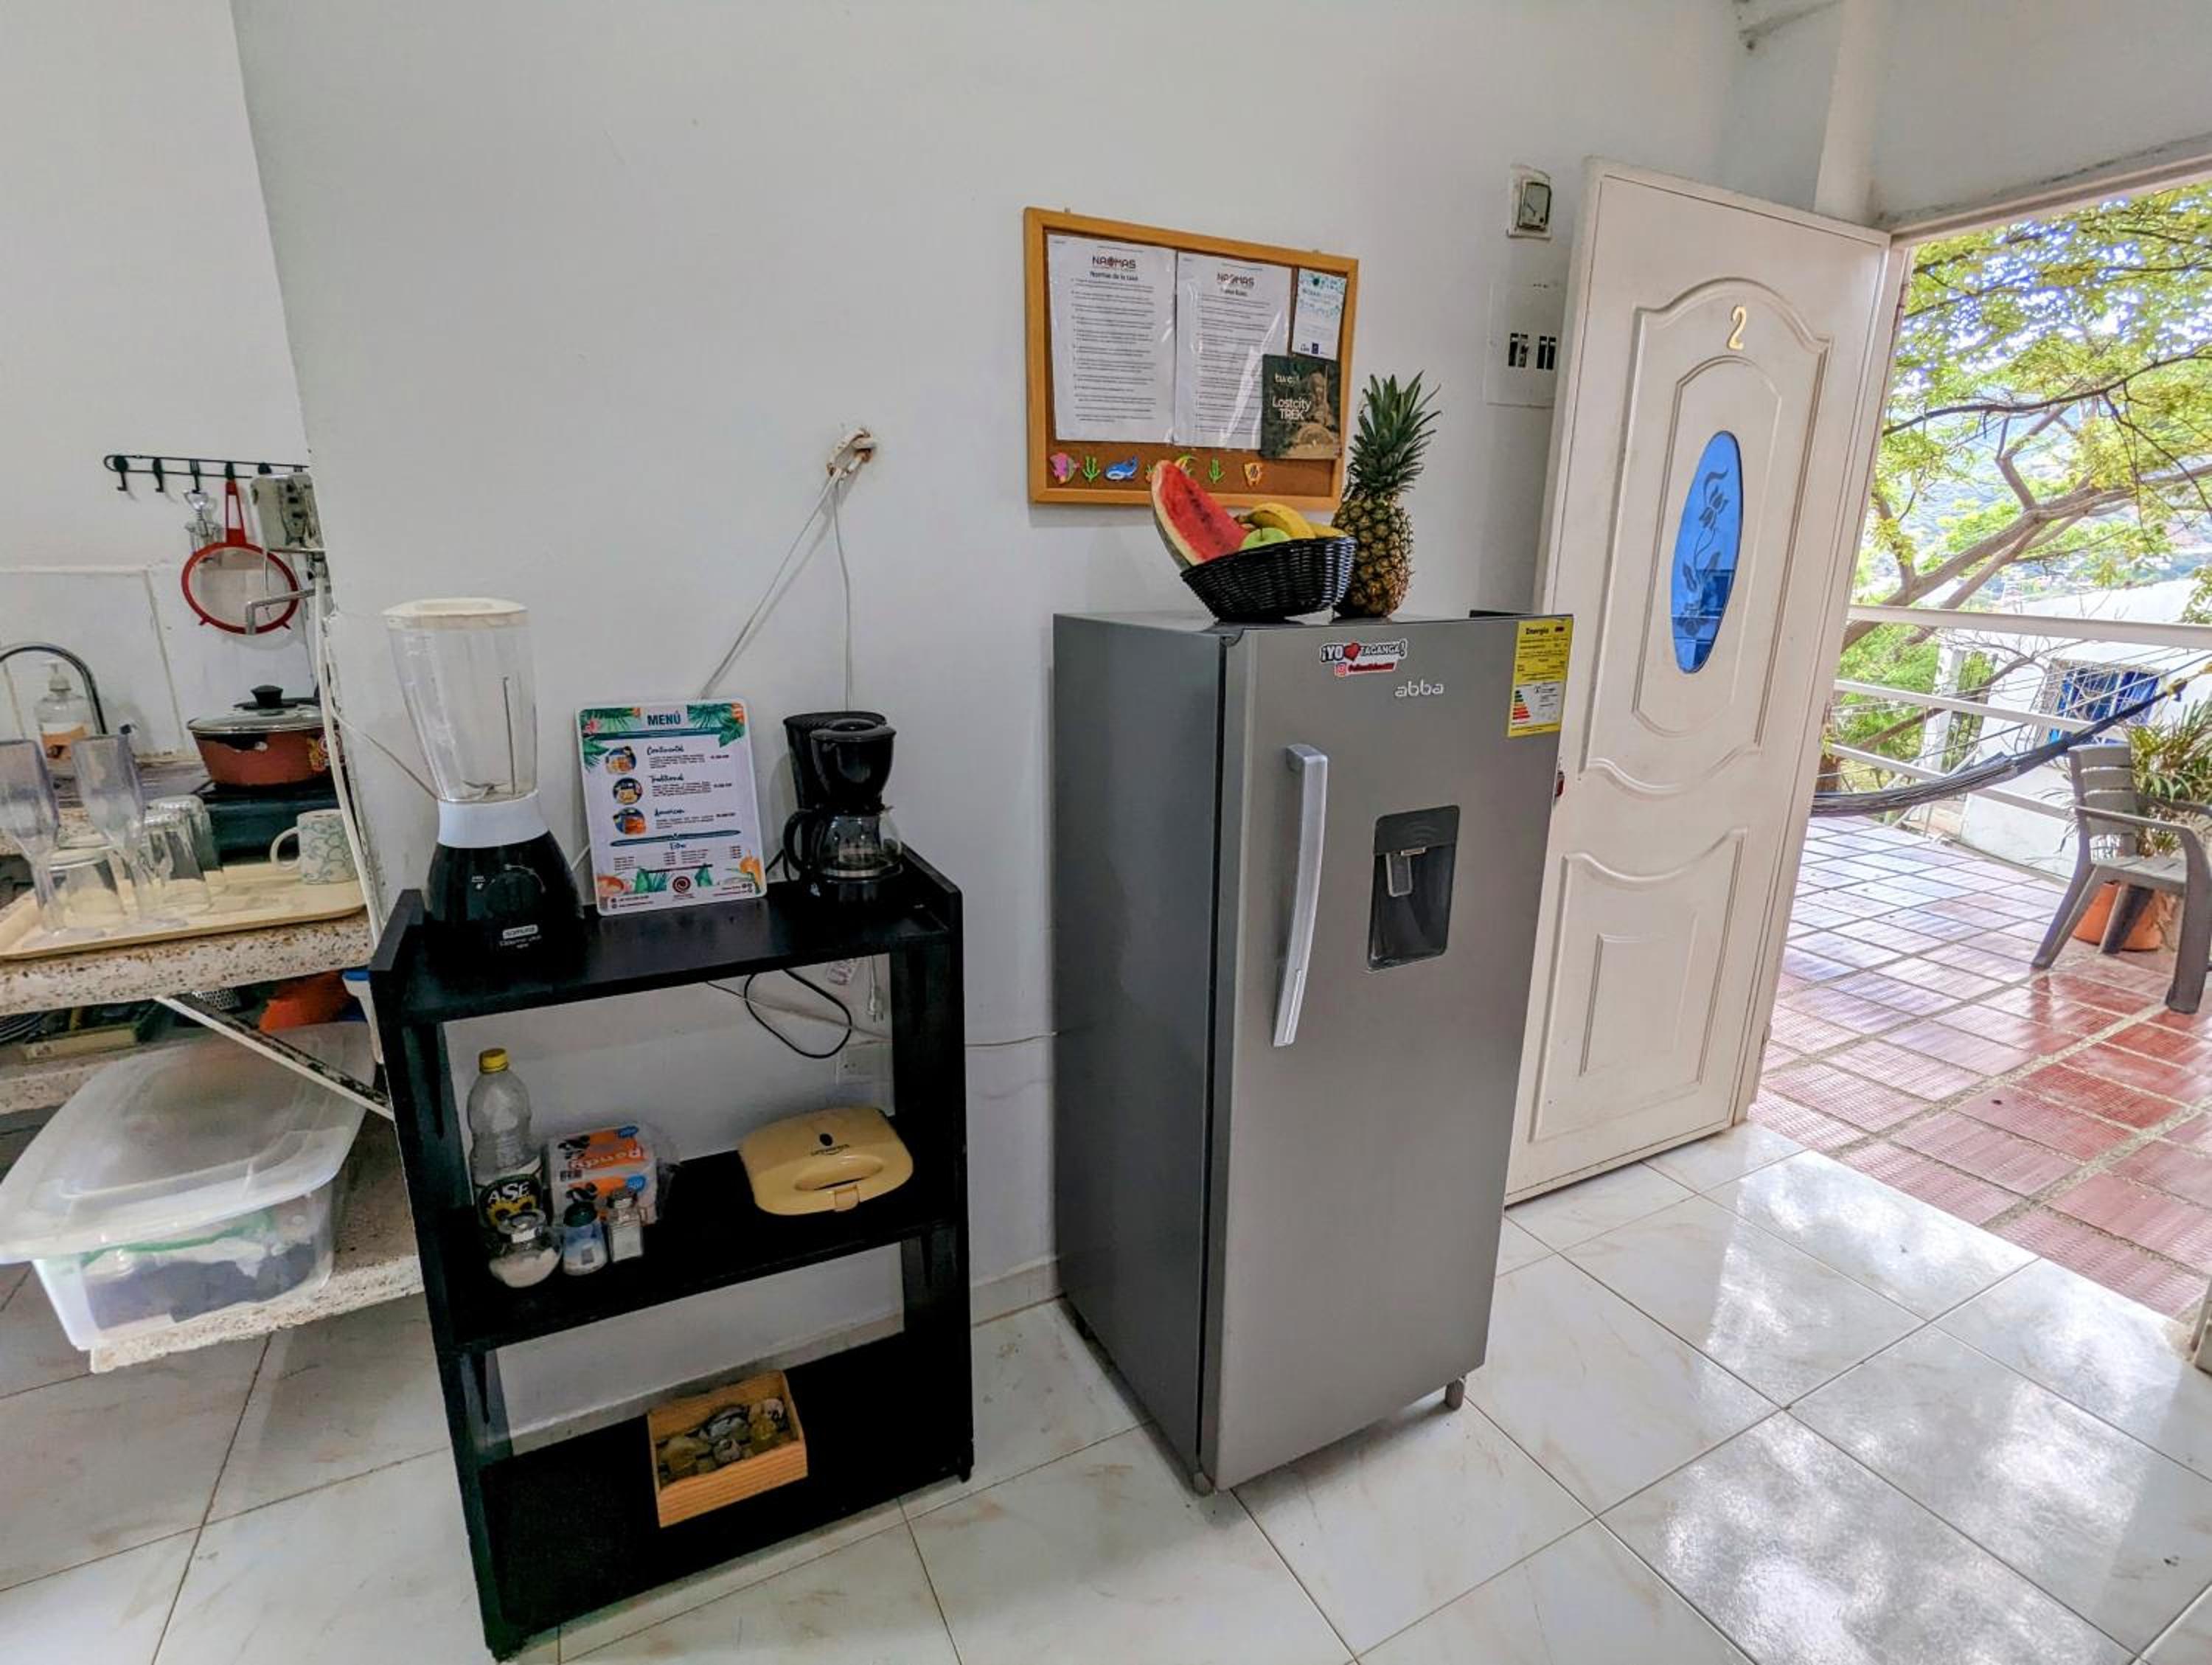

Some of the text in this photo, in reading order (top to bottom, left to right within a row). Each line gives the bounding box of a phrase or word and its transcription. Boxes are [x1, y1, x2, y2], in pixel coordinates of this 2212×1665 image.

[1726, 305, 1747, 351] 2
[1279, 408, 1304, 420] TREK
[1395, 679, 1444, 697] abba
[647, 710, 681, 726] MENÚ
